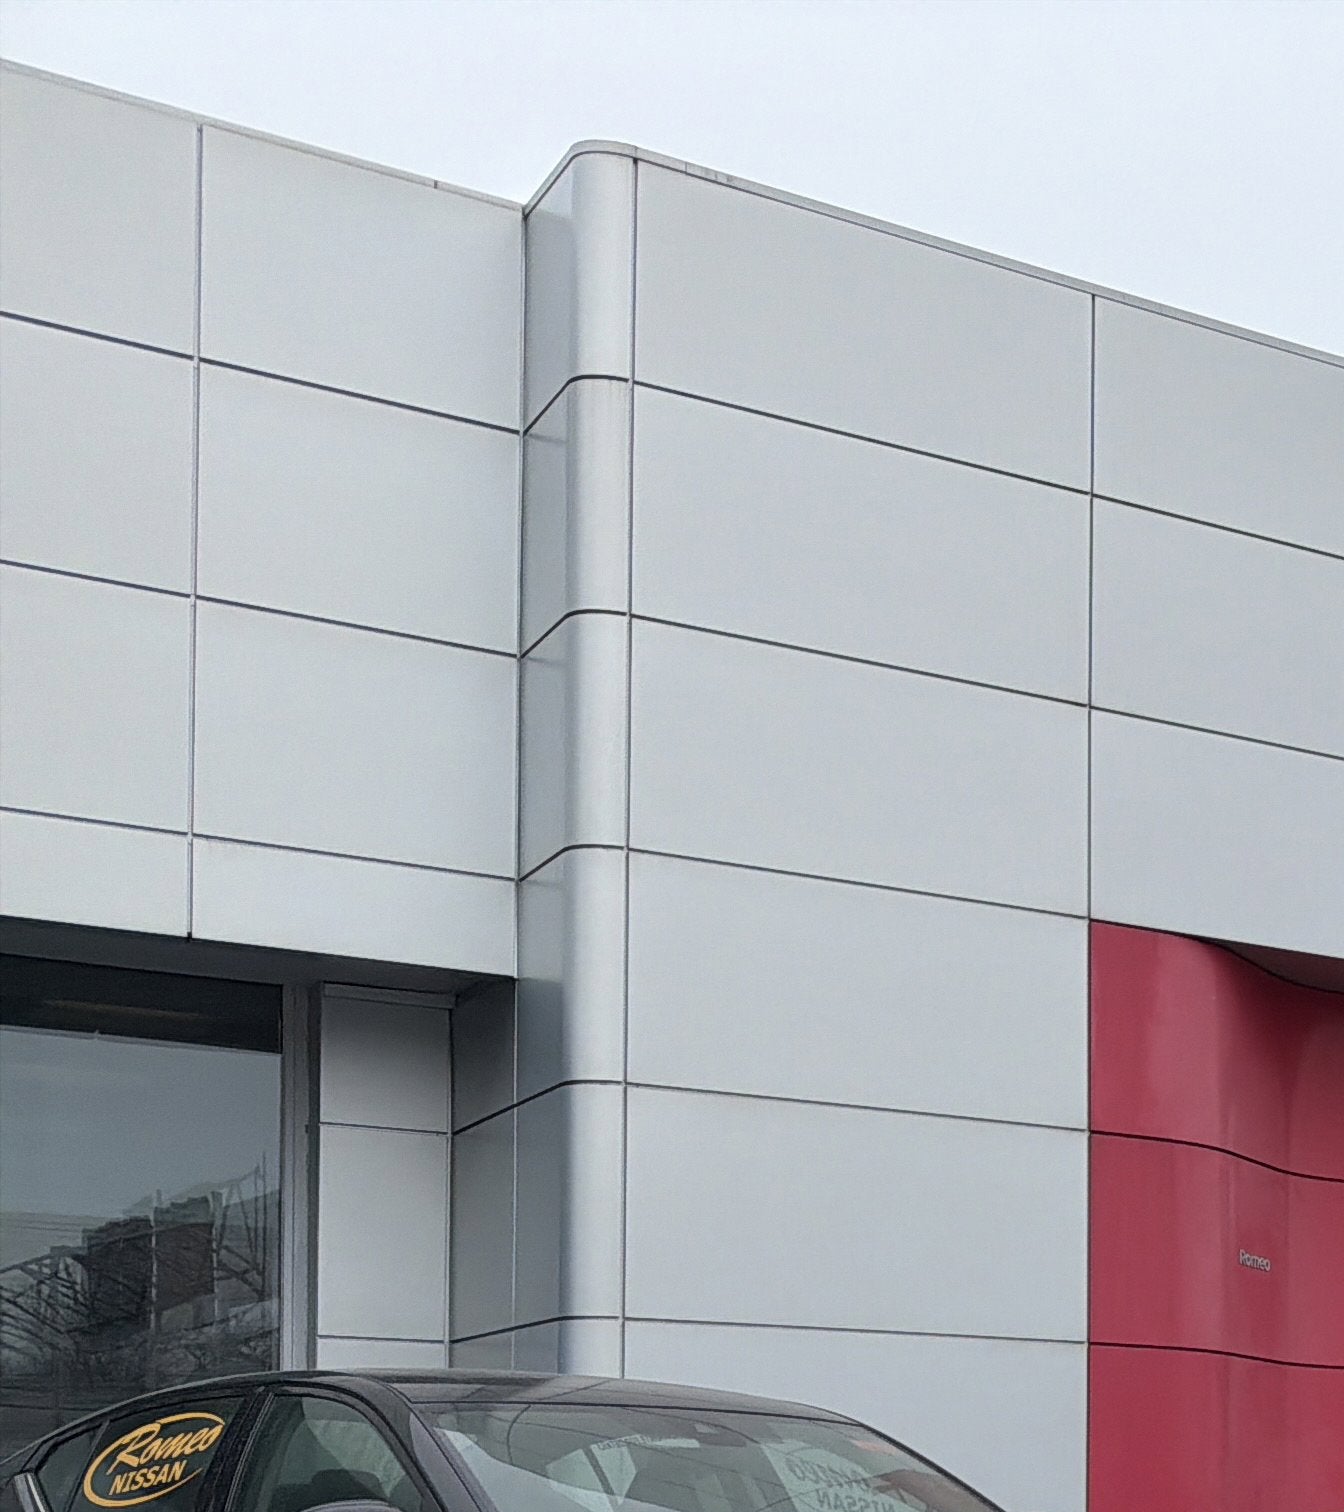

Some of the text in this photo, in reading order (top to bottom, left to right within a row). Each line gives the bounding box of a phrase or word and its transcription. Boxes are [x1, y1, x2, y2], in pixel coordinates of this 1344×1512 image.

[1239, 1249, 1271, 1272] Romeo
[106, 1422, 224, 1476] Romeo
[109, 1459, 188, 1496] NISSAN
